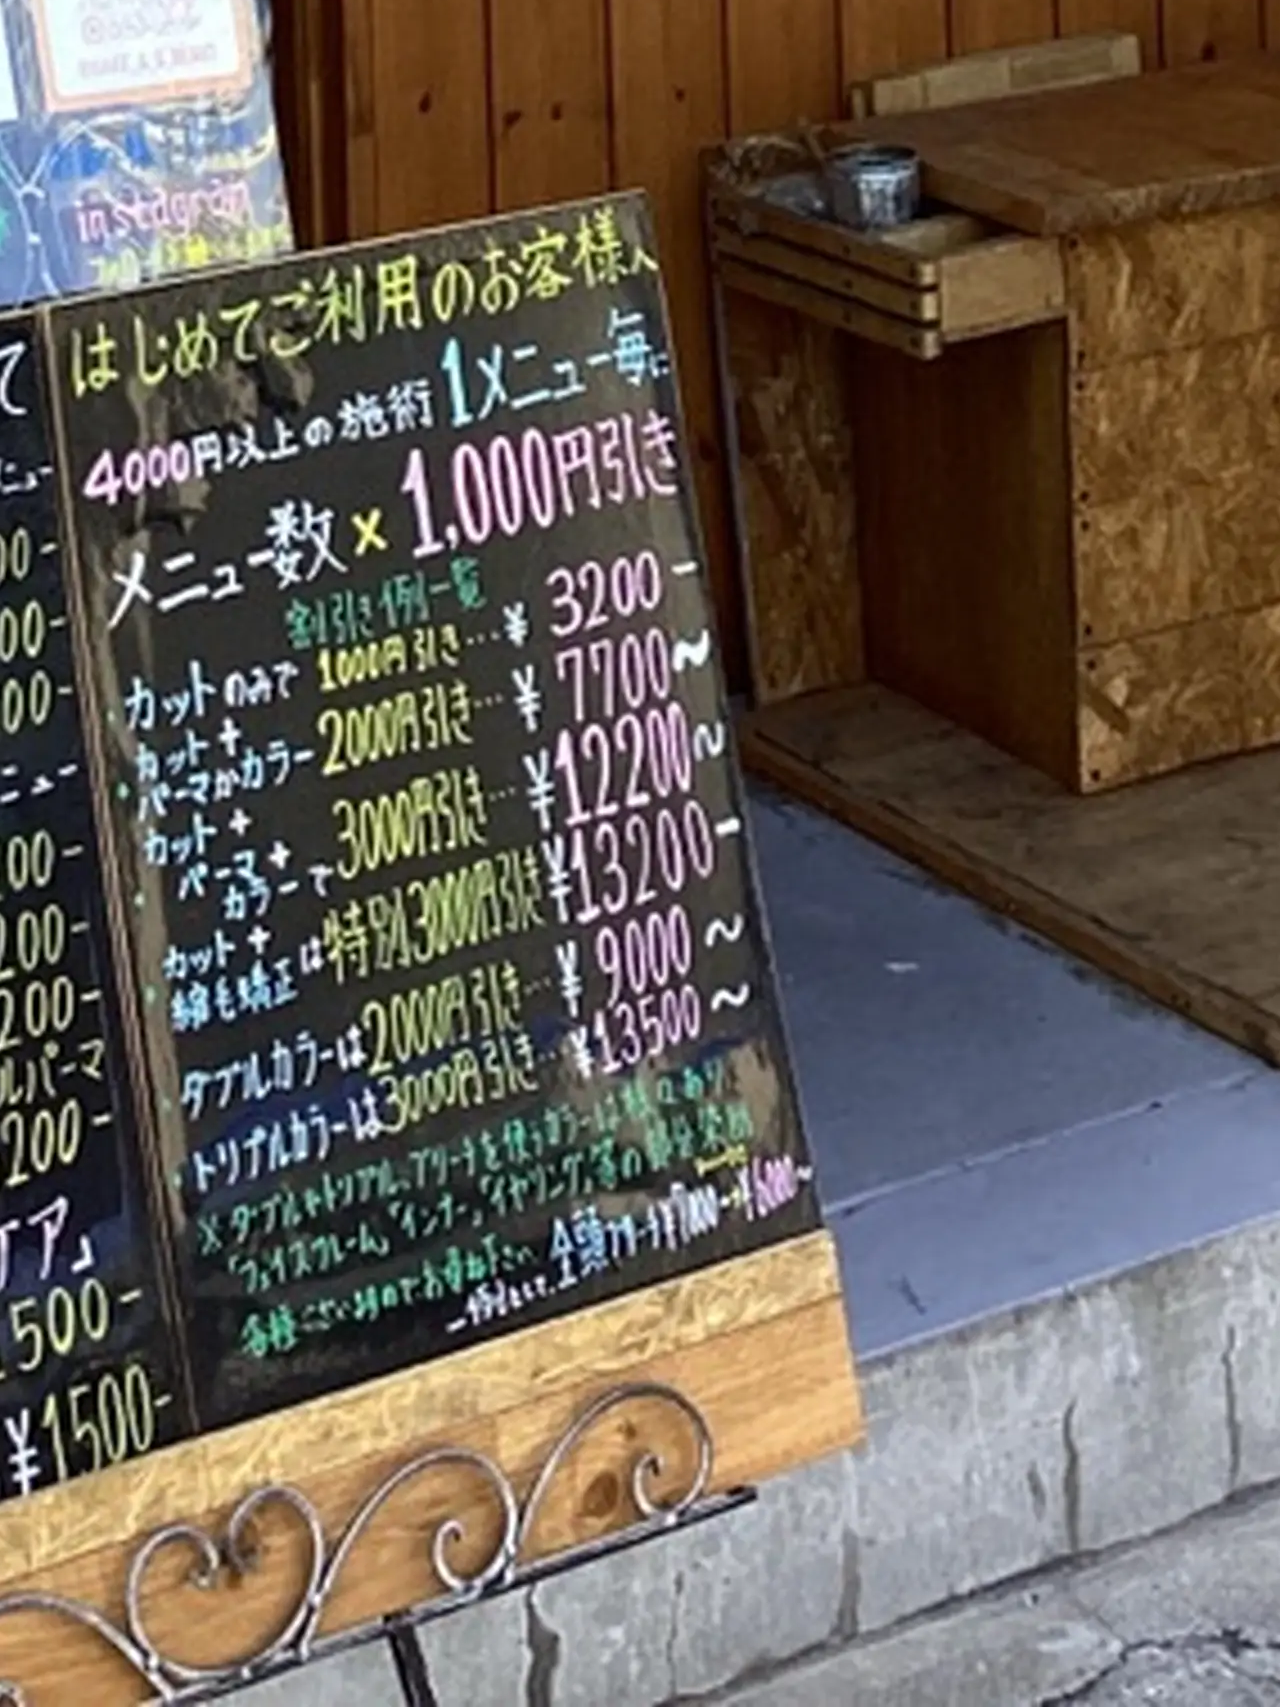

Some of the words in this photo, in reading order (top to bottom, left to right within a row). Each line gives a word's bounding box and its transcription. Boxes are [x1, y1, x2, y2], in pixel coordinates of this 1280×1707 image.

[70, 207, 659, 399] はじめてご利用のお客様へ
